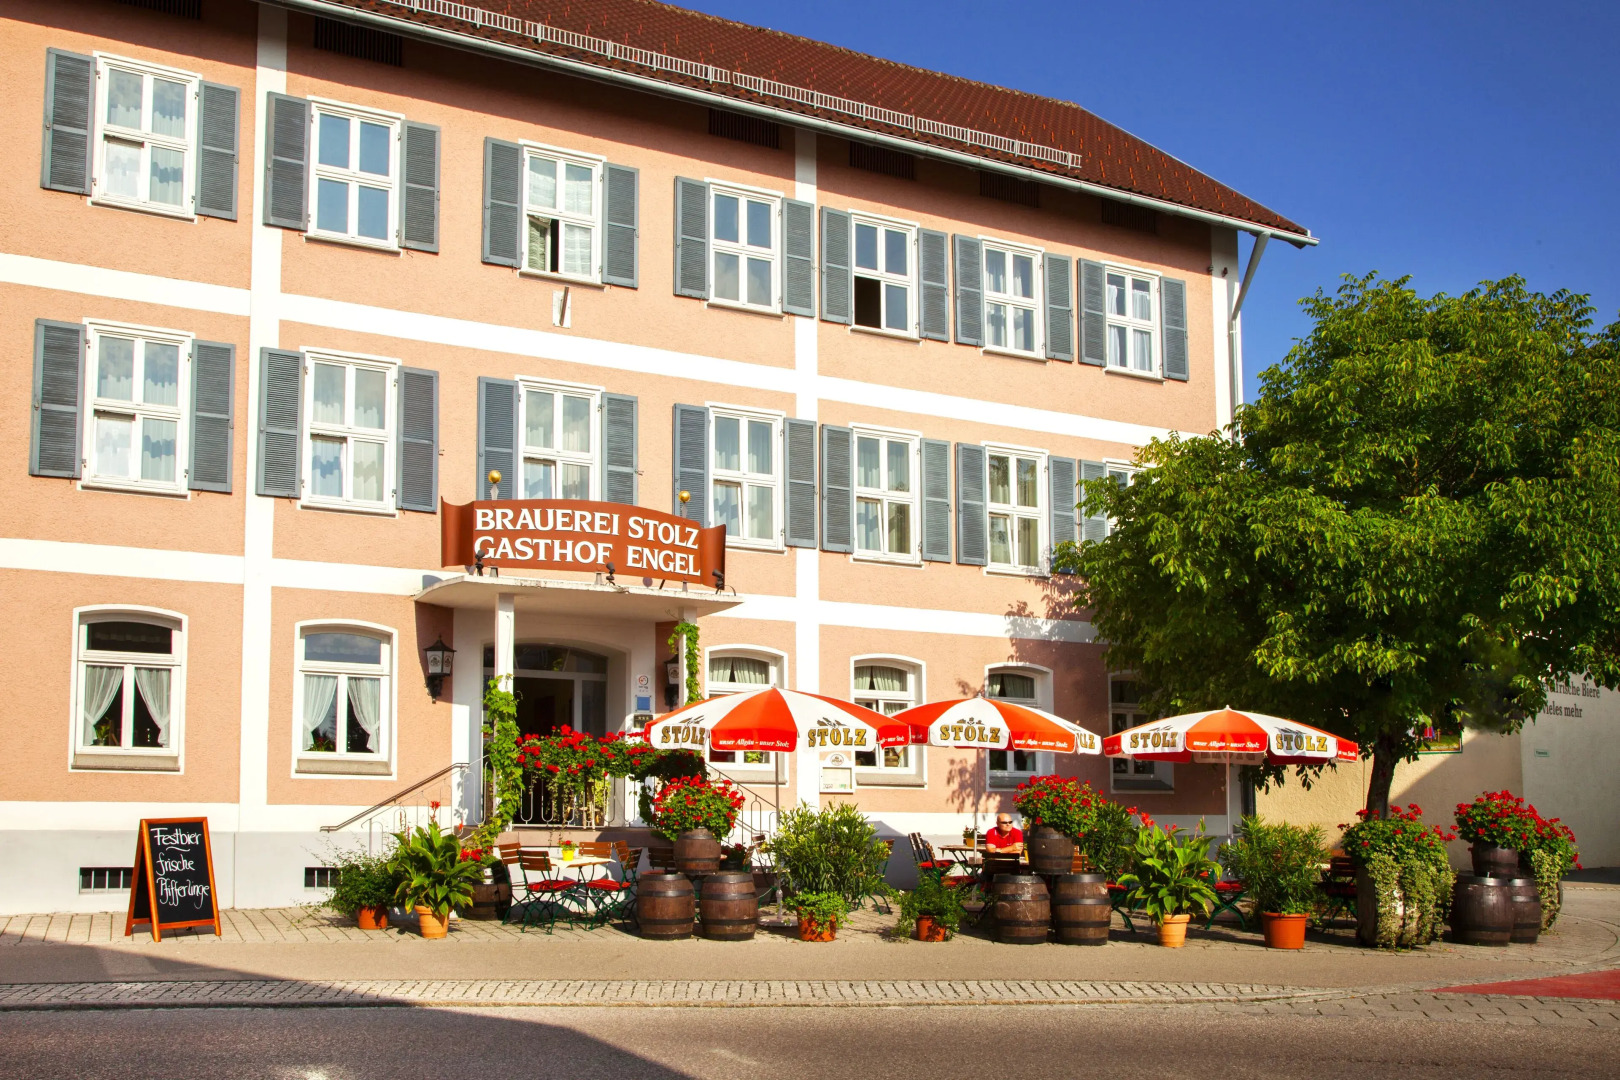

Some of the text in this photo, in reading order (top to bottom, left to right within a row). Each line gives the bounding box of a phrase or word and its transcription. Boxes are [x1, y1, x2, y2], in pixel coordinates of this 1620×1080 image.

[475, 508, 700, 550] BRAUEREI STOLZ
[474, 536, 701, 576] GASTHOF ENGEL
[1581, 682, 1600, 698] Biere
[1564, 703, 1583, 718] mehr
[661, 726, 706, 745] STOLZ
[775, 740, 790, 748] Stolz
[808, 728, 867, 747] STOLZ
[940, 725, 1001, 744] STOLZ
[1130, 732, 1178, 749] STOLZ
[1275, 734, 1328, 752] STOLZ
[150, 827, 202, 846] Festbier
[155, 852, 196, 876] frische
[156, 877, 210, 910] Pfifferlinge
